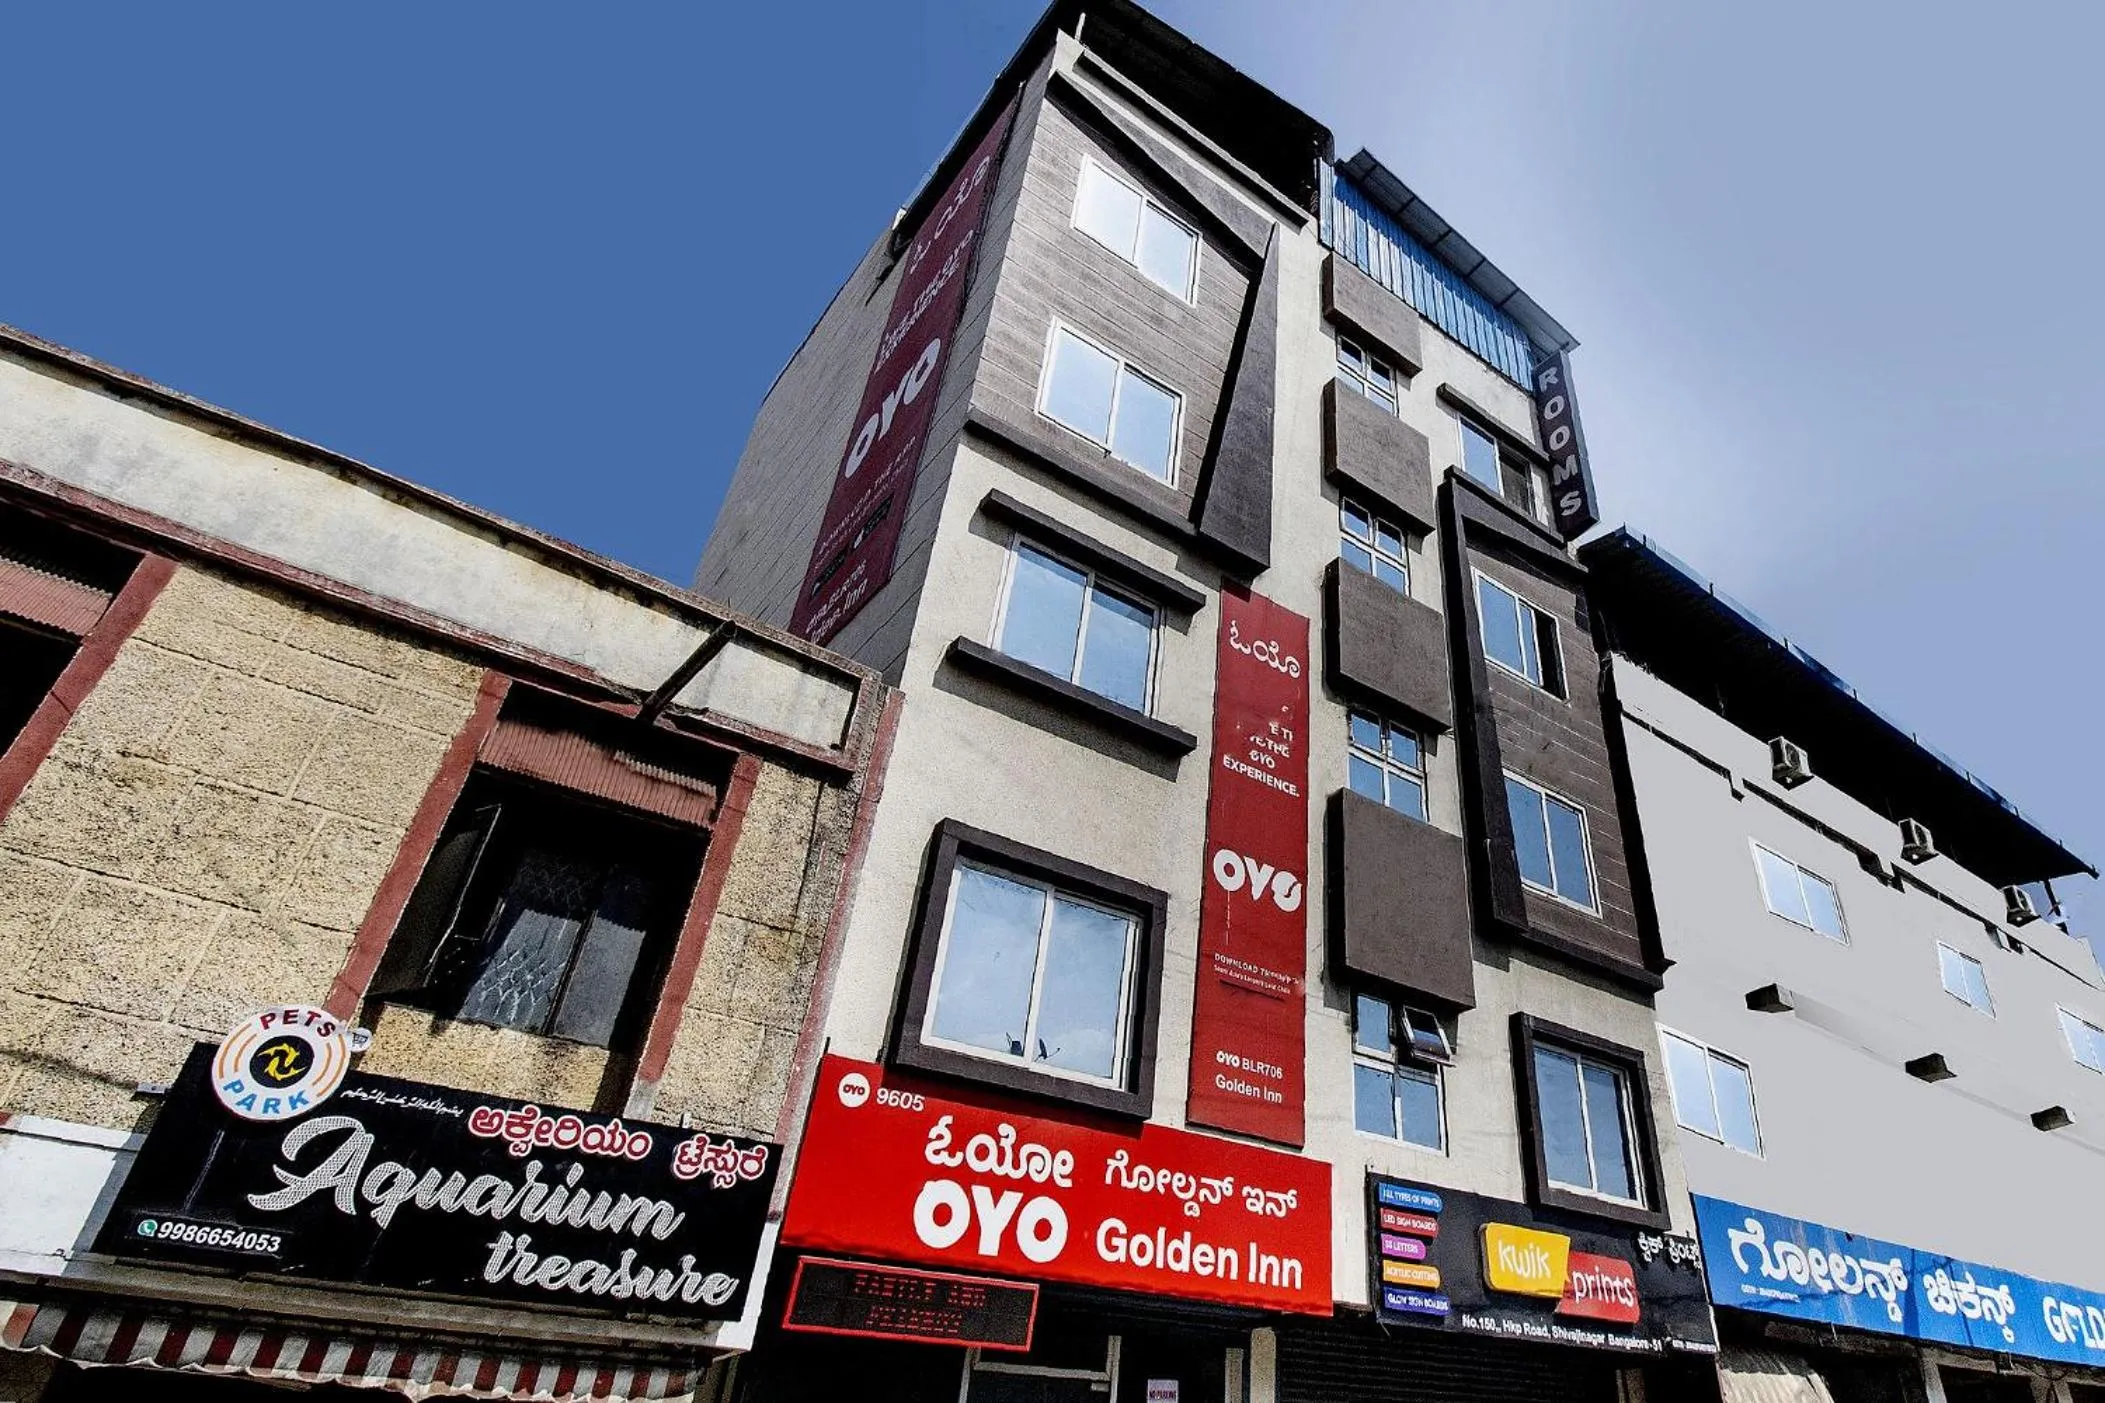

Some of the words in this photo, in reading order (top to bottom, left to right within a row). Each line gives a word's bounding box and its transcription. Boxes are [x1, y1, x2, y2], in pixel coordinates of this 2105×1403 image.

[844, 337, 943, 480] OYO
[1538, 366, 1583, 517] ROOMS
[1222, 753, 1301, 798] EXPERIENCE.
[1213, 848, 1302, 913] OYO
[1214, 951, 1259, 974] DOWNLOAD
[259, 1008, 337, 1038] PETS
[1216, 1049, 1240, 1068] OYO
[1242, 1056, 1284, 1080] BLR706
[222, 1078, 310, 1116] PARK
[842, 1083, 866, 1096] OYO
[876, 1087, 926, 1113] 9605
[1215, 1073, 1261, 1099] Golden
[1263, 1085, 1283, 1105] Inn
[247, 1115, 688, 1242] Aquarium
[924, 1114, 1074, 1188] ಓಯೋ
[1241, 1185, 1298, 1219] ಇನ್
[156, 1220, 282, 1253] 9986654053
[912, 1178, 1069, 1264] OYO
[1096, 1216, 1241, 1281] Golden
[1248, 1241, 1304, 1291] Inn
[484, 1229, 741, 1307] treasure
[1498, 1239, 1551, 1279] kwik
[1572, 1265, 1635, 1308] prints
